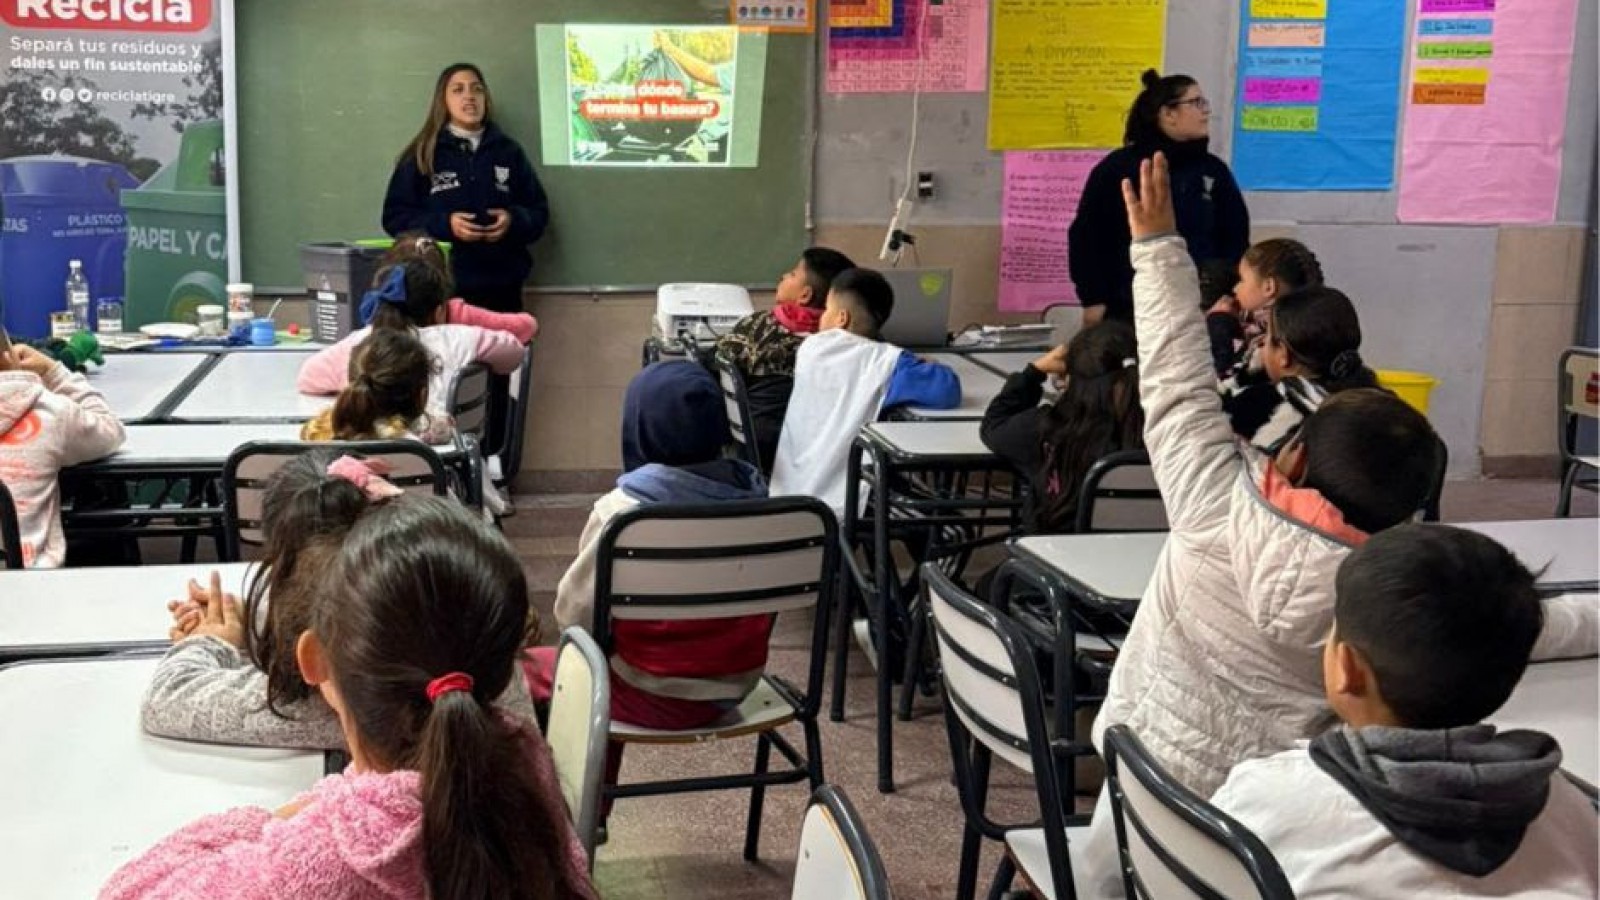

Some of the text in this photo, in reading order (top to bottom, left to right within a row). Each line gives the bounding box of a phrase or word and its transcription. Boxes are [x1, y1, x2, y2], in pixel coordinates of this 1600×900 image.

[17, 0, 192, 23] Recicla
[10, 36, 202, 57] Separá tus residuos y
[11, 56, 203, 73] dales un fin sustentable
[96, 90, 175, 104] reciclatigre
[3, 218, 28, 232] TAS
[128, 226, 226, 260] PAPEL Y C
